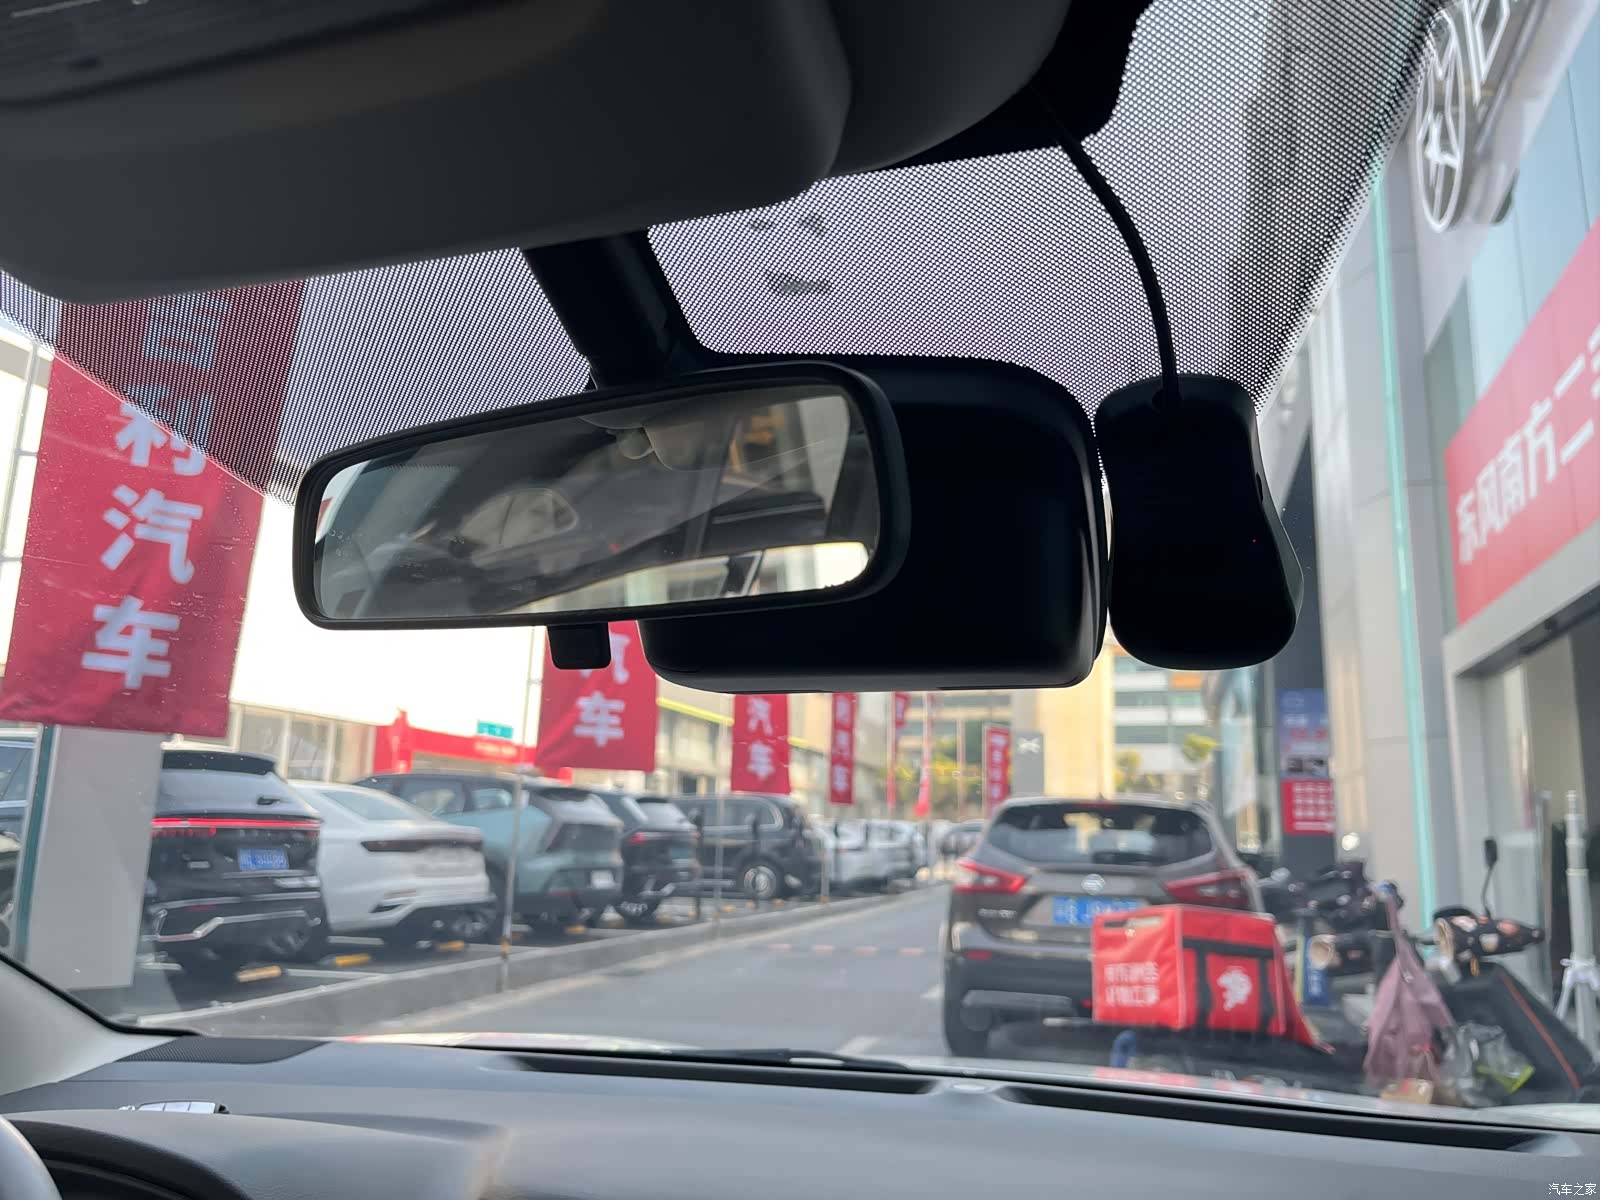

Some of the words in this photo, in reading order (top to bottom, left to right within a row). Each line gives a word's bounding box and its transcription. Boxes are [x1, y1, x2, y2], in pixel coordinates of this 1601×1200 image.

[1456, 322, 1601, 566] 东风南方二
